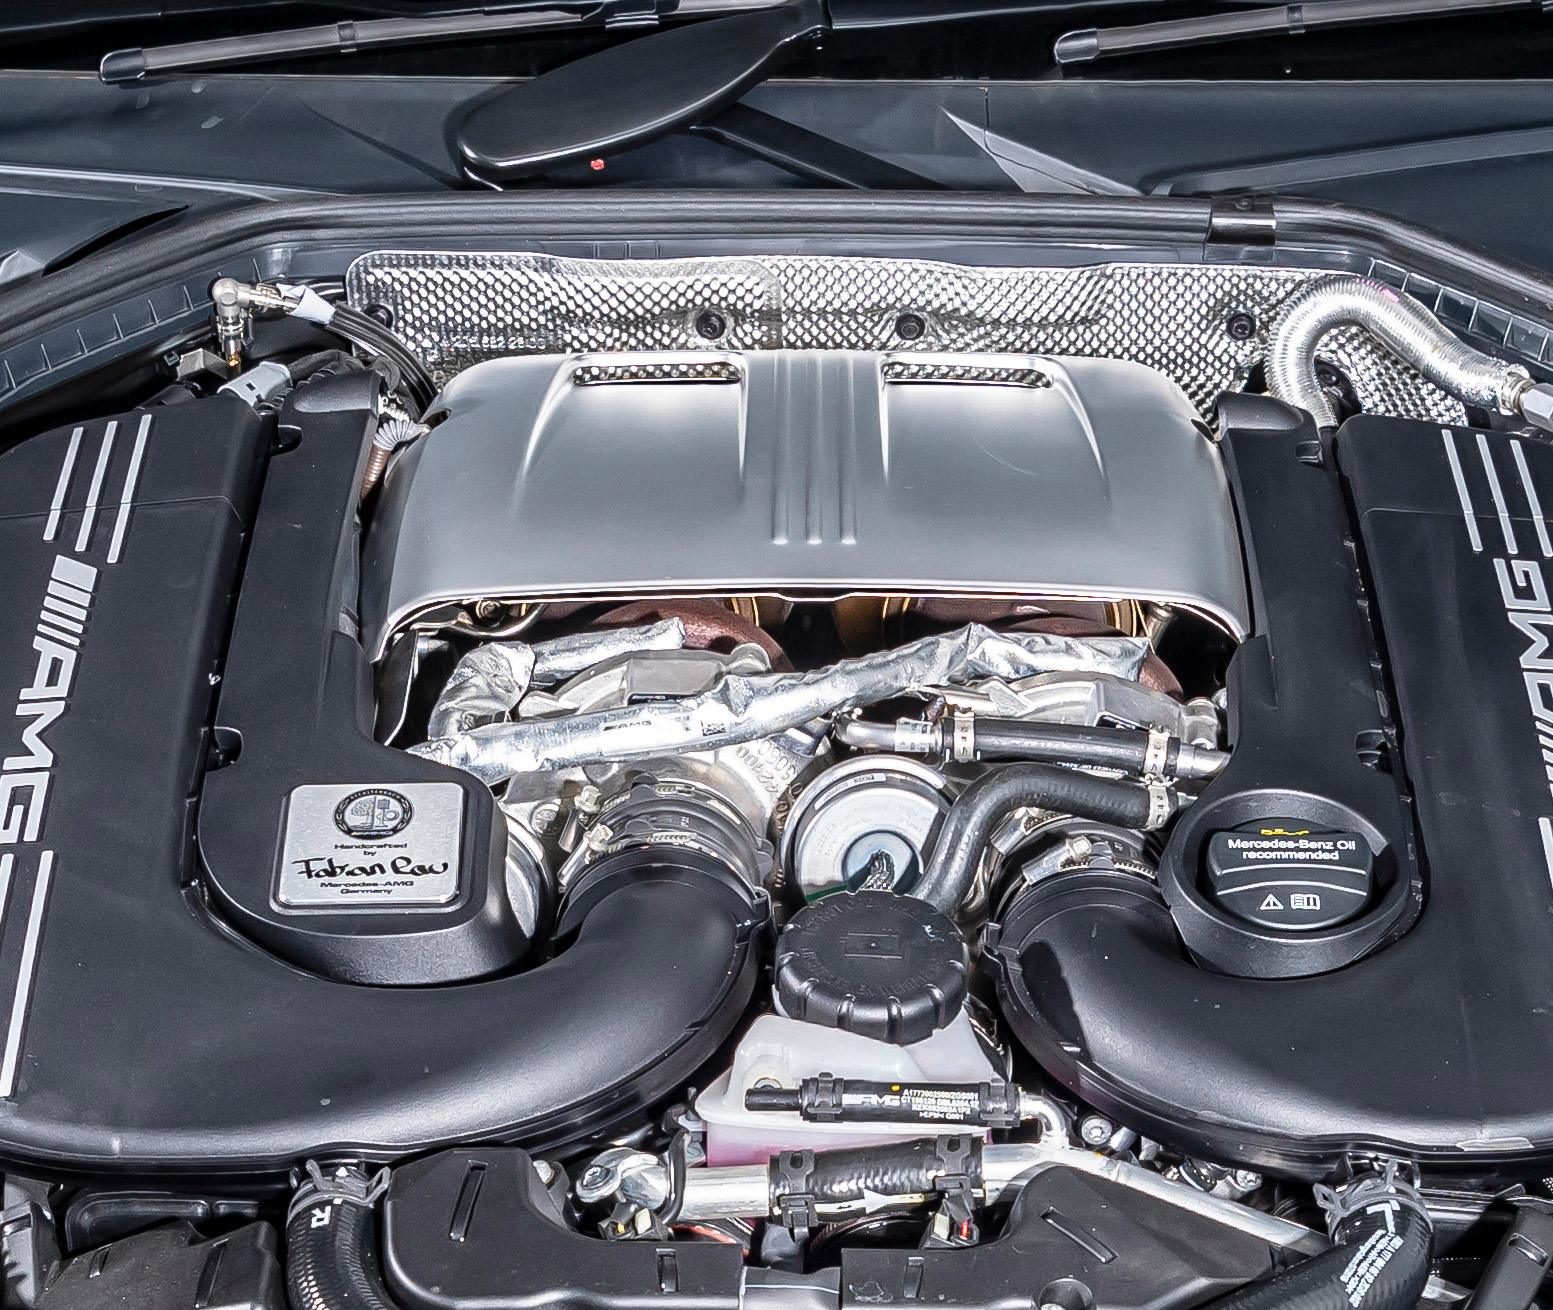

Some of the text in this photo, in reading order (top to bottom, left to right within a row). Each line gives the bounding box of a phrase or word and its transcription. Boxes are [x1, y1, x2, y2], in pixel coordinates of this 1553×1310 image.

[1228, 838, 1356, 851] Mercedes-Benz Oil
[1242, 850, 1340, 861] recommended
